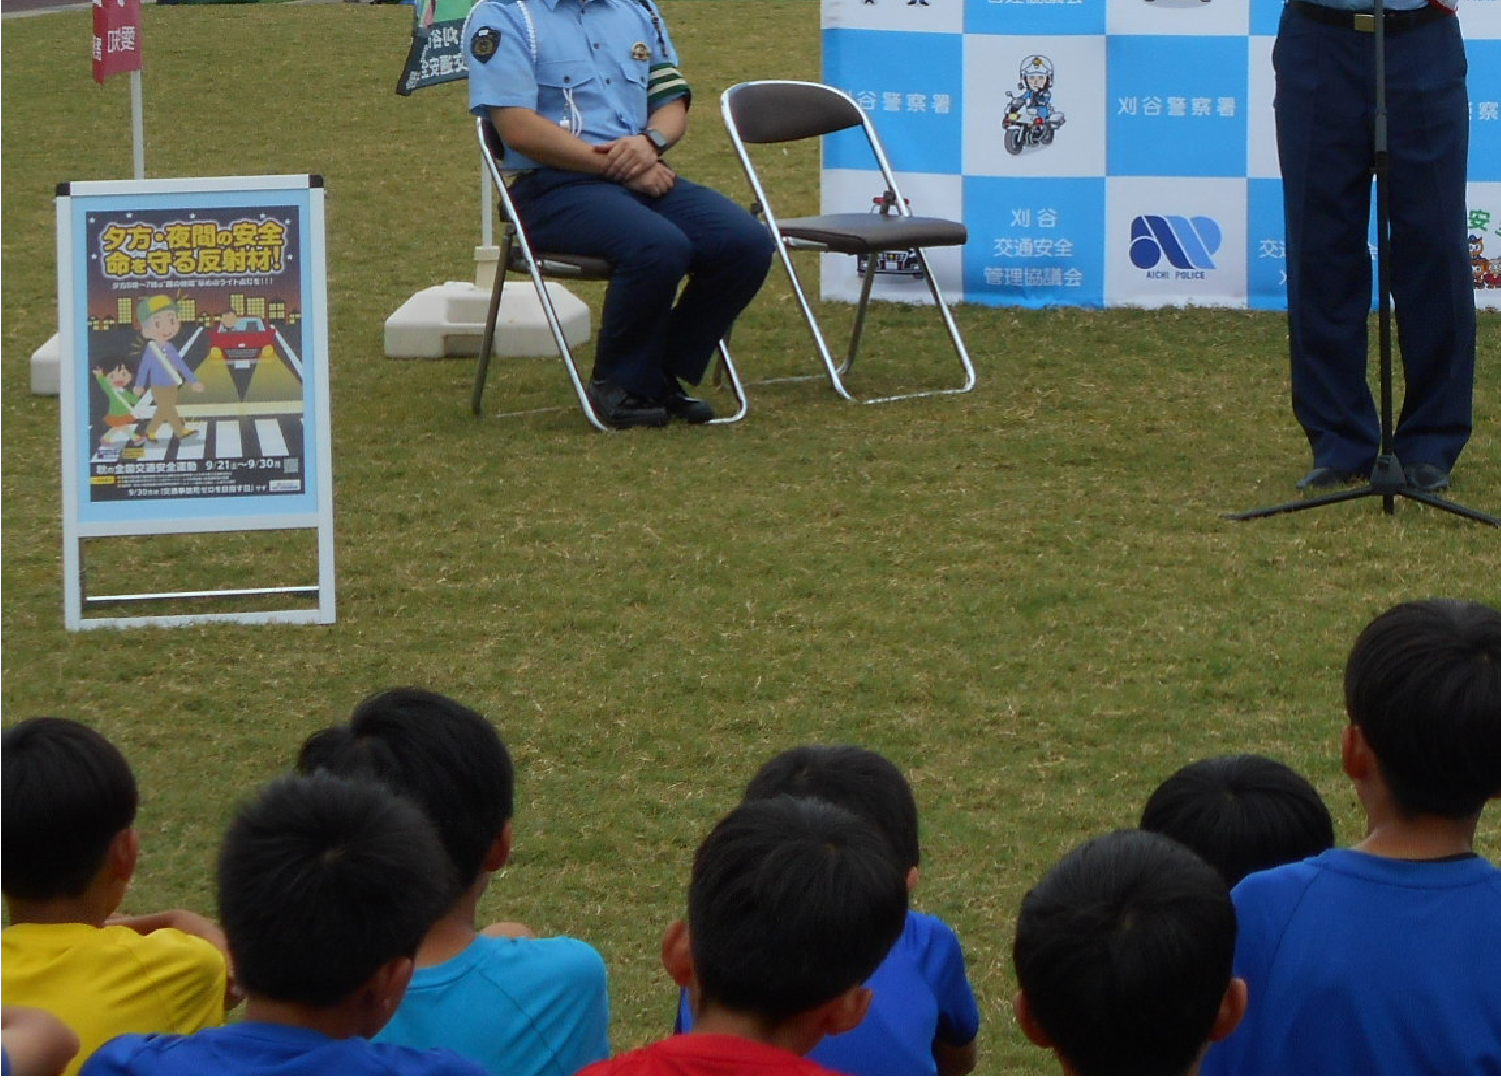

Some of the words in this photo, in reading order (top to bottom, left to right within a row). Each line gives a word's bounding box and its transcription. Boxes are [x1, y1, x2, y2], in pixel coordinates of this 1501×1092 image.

[852, 91, 951, 116] 谷警察署
[1118, 96, 1236, 116] 刈谷警察署
[1011, 208, 1057, 228] 刈谷
[102, 220, 286, 251] 夕方・夜間の安全
[994, 238, 1072, 256] 交通安全
[984, 267, 1082, 286] 管理協議会
[1145, 269, 1170, 279] AICHI
[1175, 270, 1206, 281] POLICE
